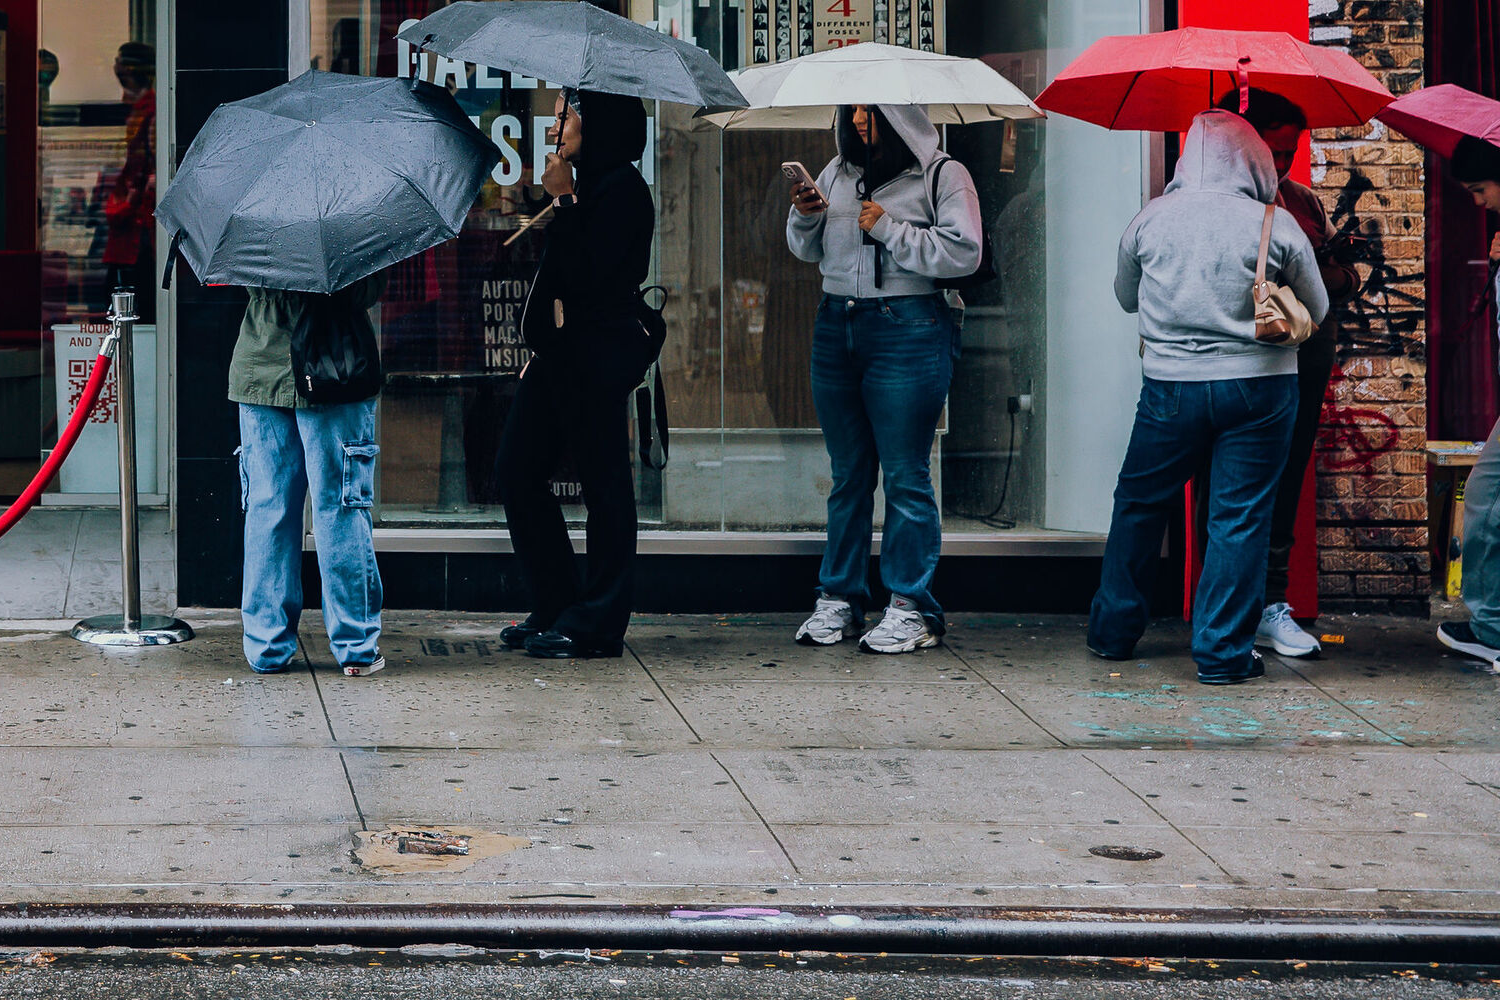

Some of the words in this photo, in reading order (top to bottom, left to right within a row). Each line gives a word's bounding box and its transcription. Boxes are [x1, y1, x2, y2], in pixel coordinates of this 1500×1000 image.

[79, 323, 113, 334] HOUR
[484, 325, 524, 345] MAC
[69, 337, 92, 348] AND
[485, 348, 529, 367] INSID
